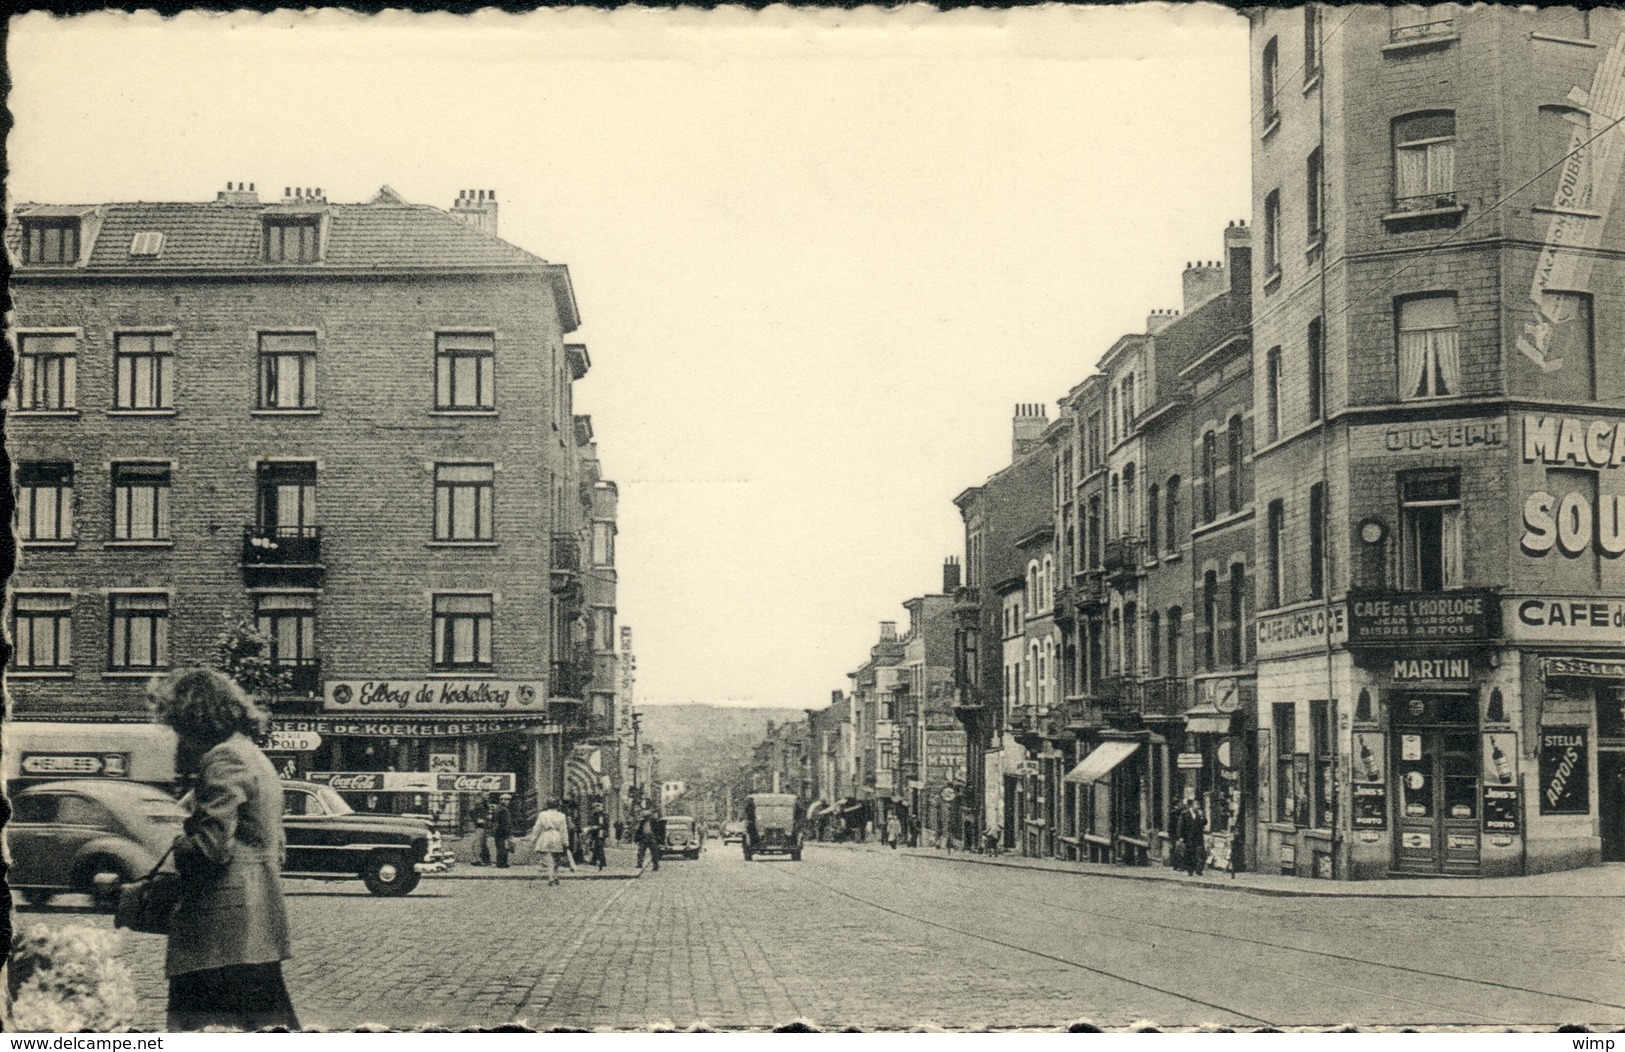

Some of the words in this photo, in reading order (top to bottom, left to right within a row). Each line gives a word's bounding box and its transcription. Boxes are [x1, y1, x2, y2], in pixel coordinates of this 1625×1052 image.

[1354, 601, 1390, 616] CAFE
[1518, 600, 1609, 627] CAFE
[1394, 658, 1469, 679] MARTINI
[271, 721, 328, 733] SERIE
[271, 740, 309, 749] POLD
[1545, 735, 1583, 747] STELLA
[1546, 746, 1578, 807] ARTOIS
